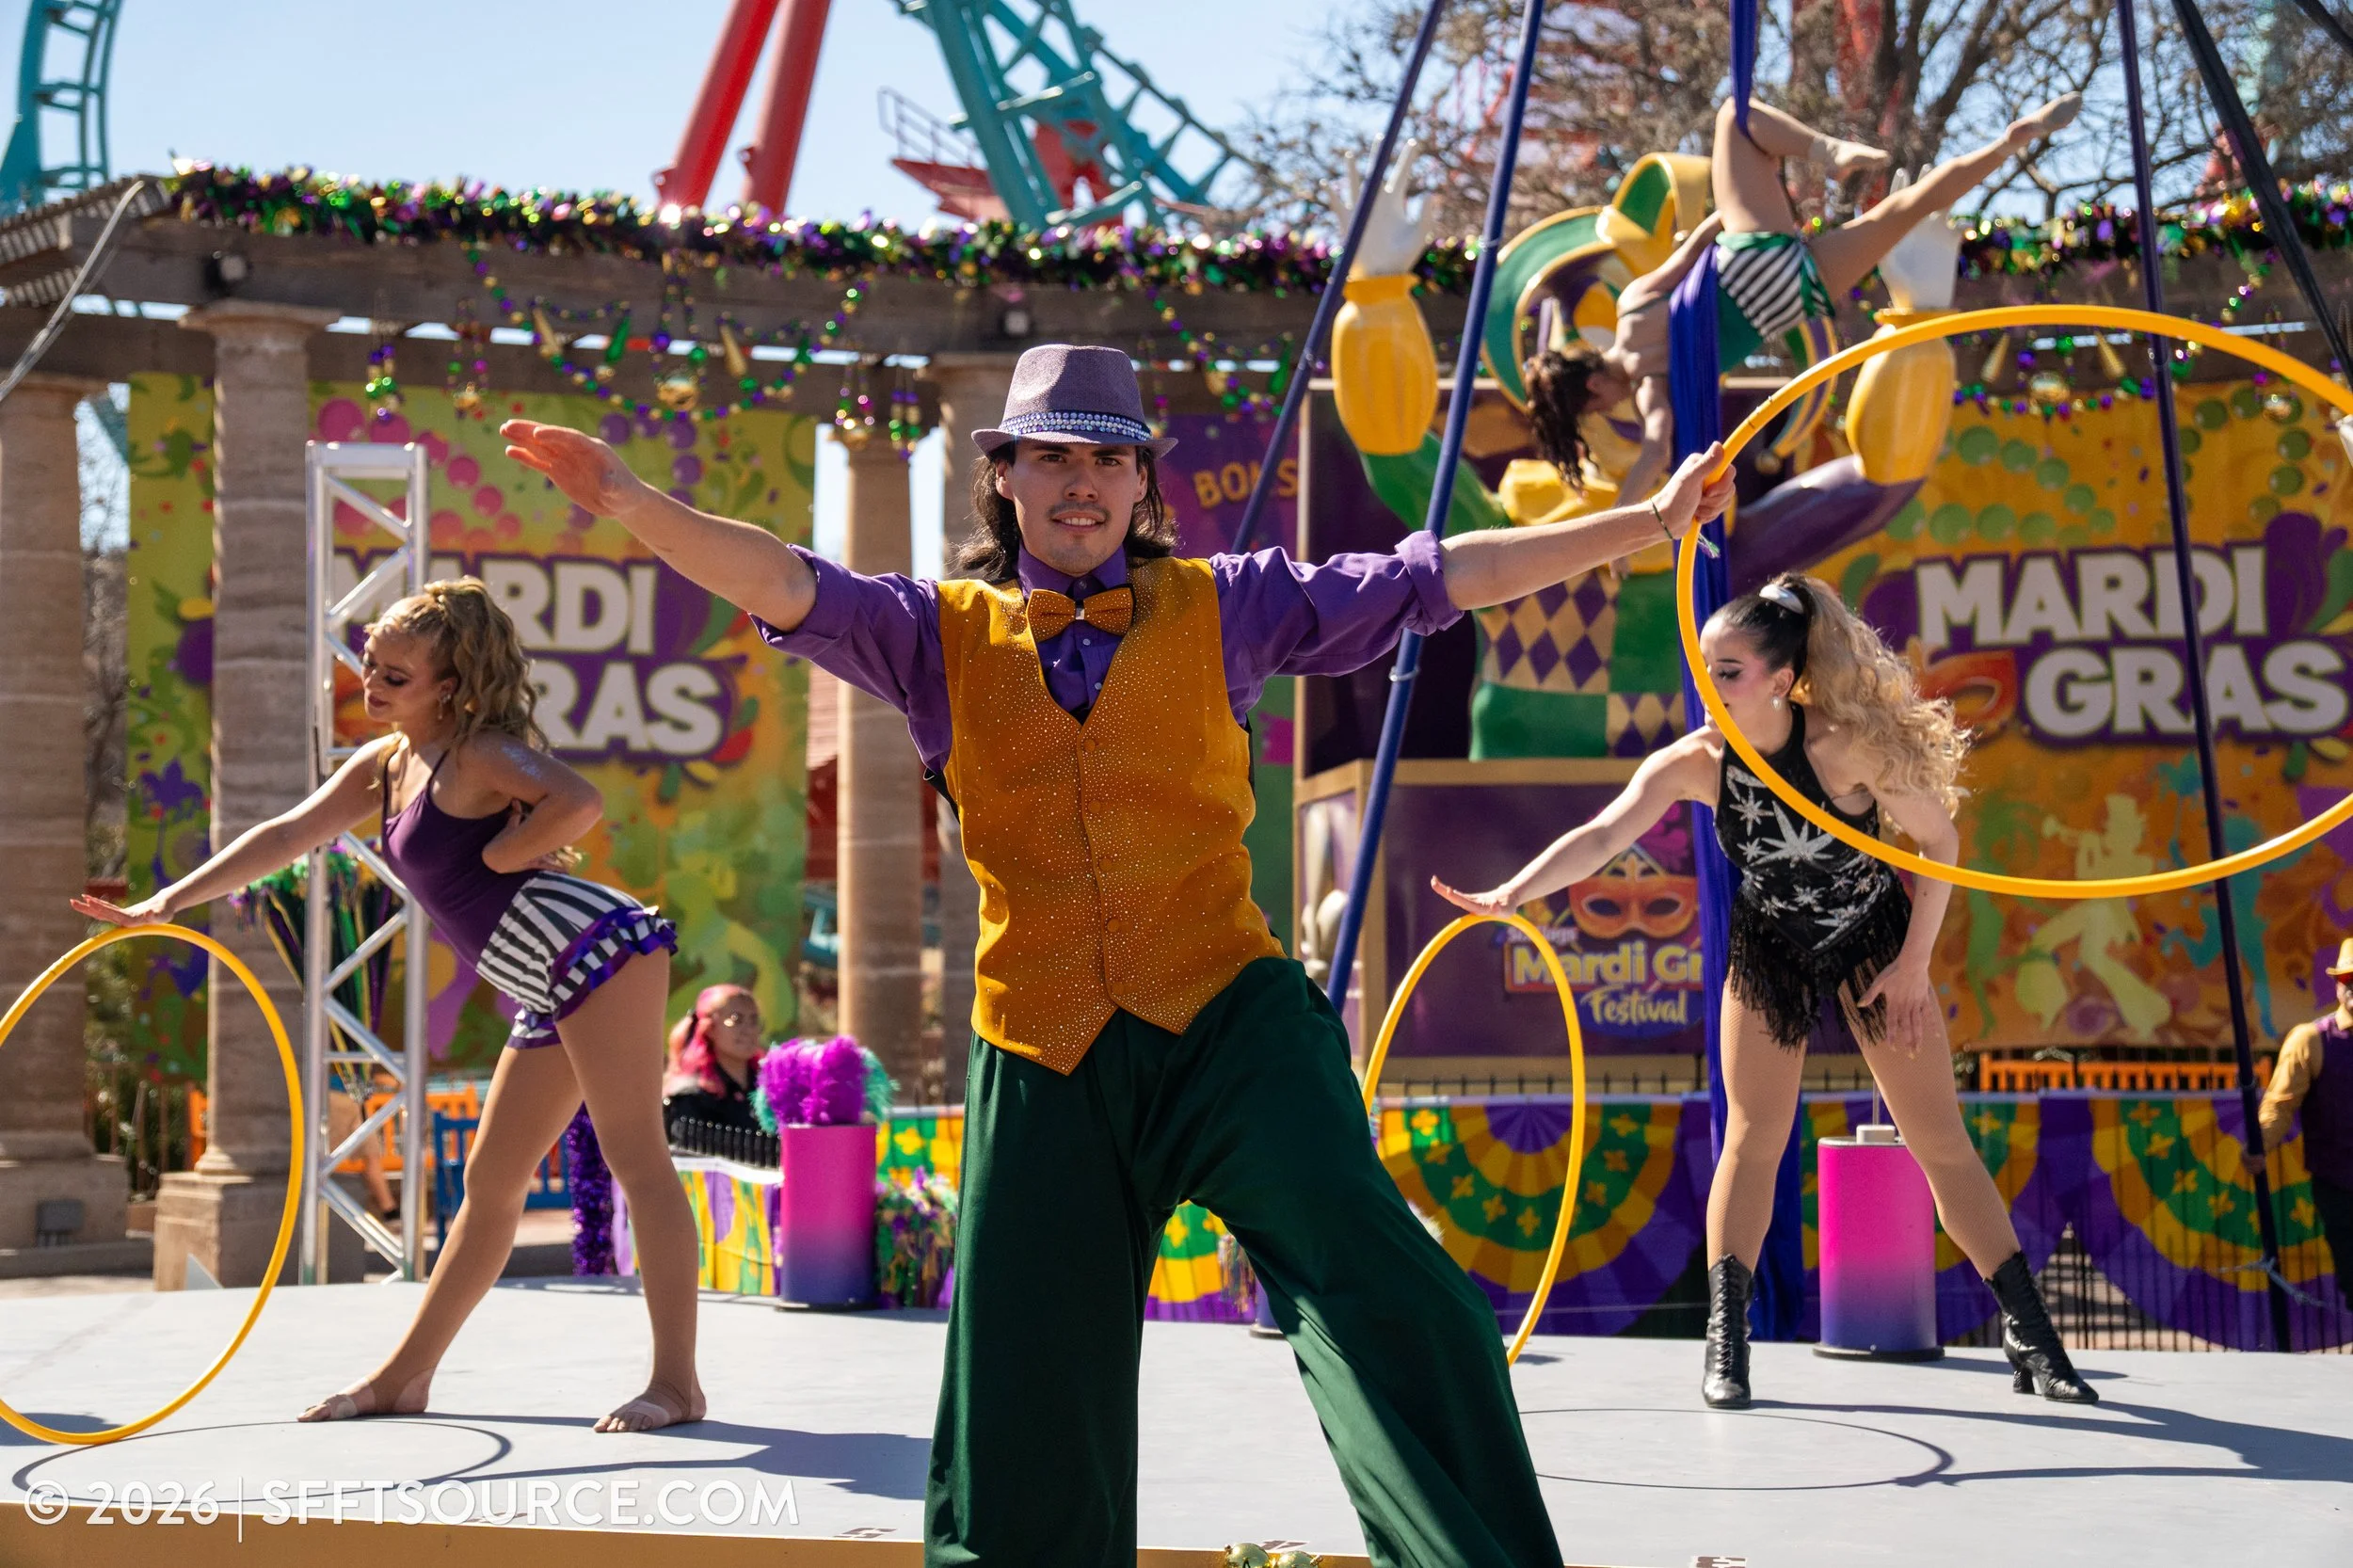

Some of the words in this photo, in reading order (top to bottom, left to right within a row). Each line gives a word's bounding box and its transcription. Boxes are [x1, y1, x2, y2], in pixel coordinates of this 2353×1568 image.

[1917, 548, 2266, 646] MARDI
[523, 659, 722, 754] RAS
[2025, 640, 2348, 738] GRAS
[1513, 941, 1646, 984] Mardi
[1579, 983, 1689, 1026] Festival
